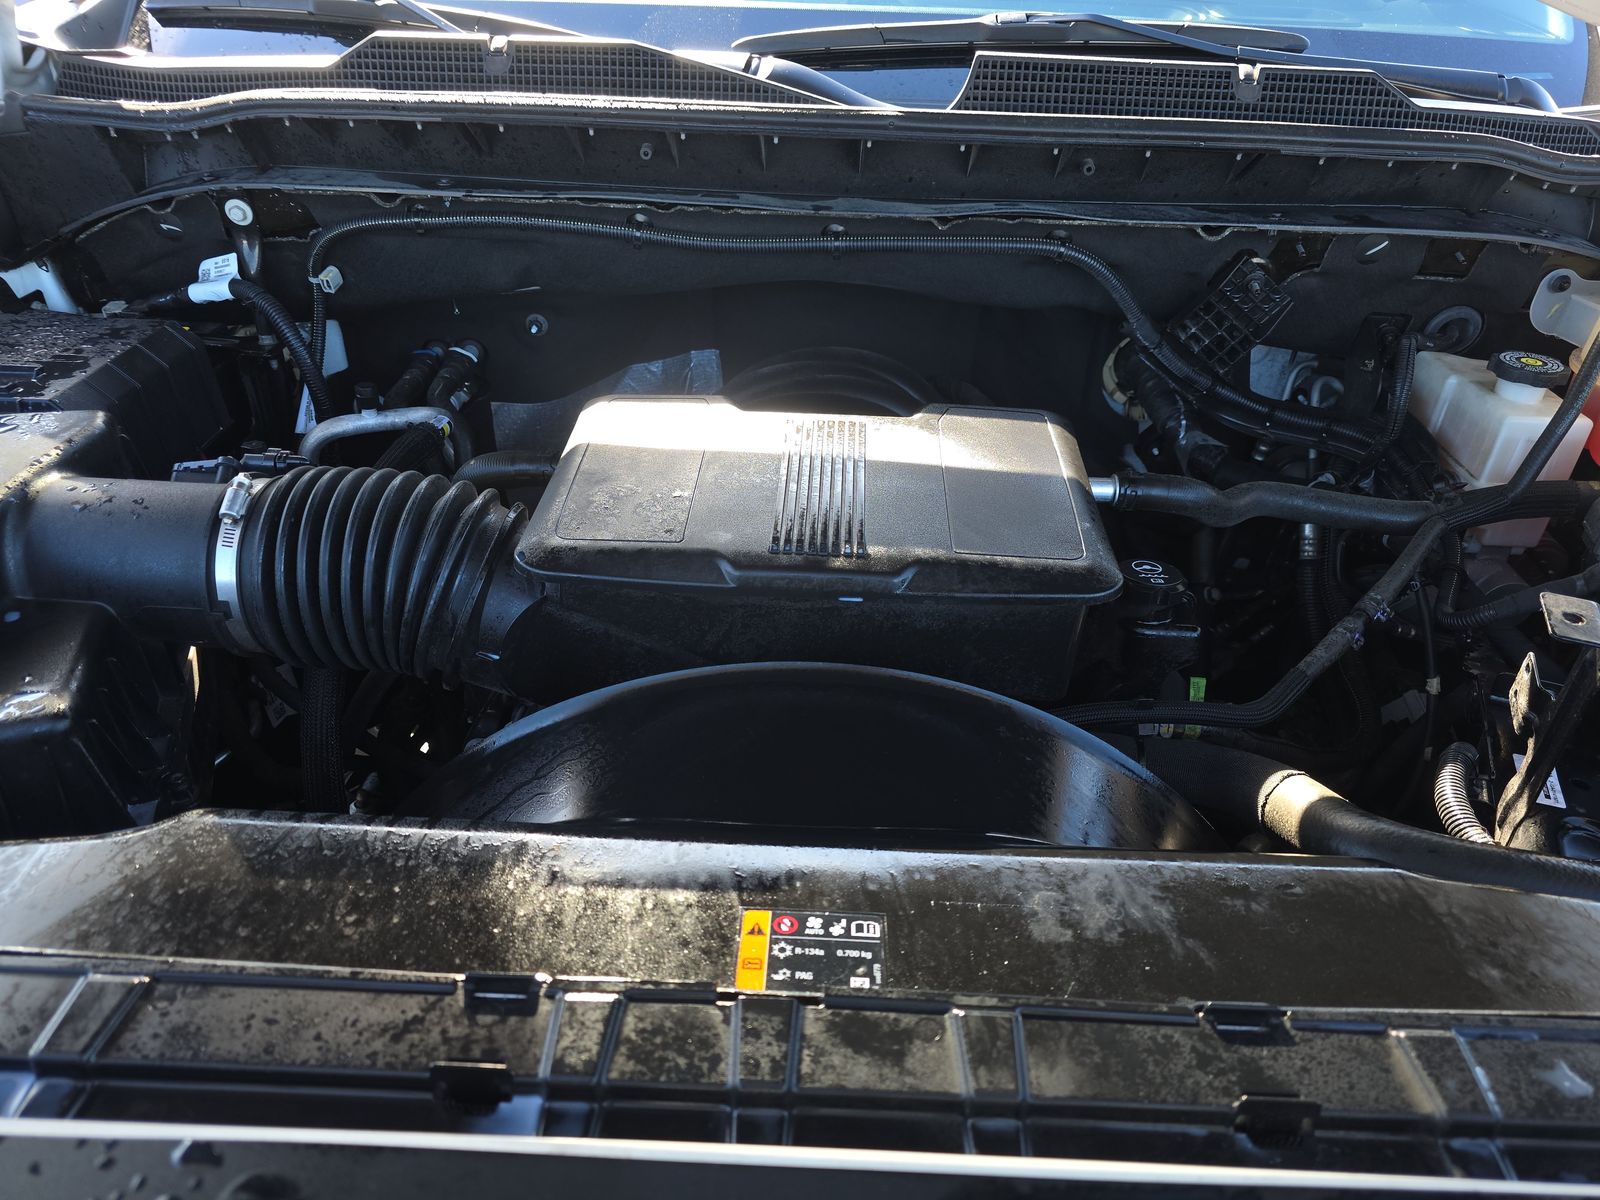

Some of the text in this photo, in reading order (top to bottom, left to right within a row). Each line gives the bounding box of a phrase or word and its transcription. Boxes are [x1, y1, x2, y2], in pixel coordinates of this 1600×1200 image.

[804, 928, 825, 936] AUTO
[794, 947, 825, 956] R-134a
[861, 950, 873, 960] kg
[794, 971, 814, 981] PAG
